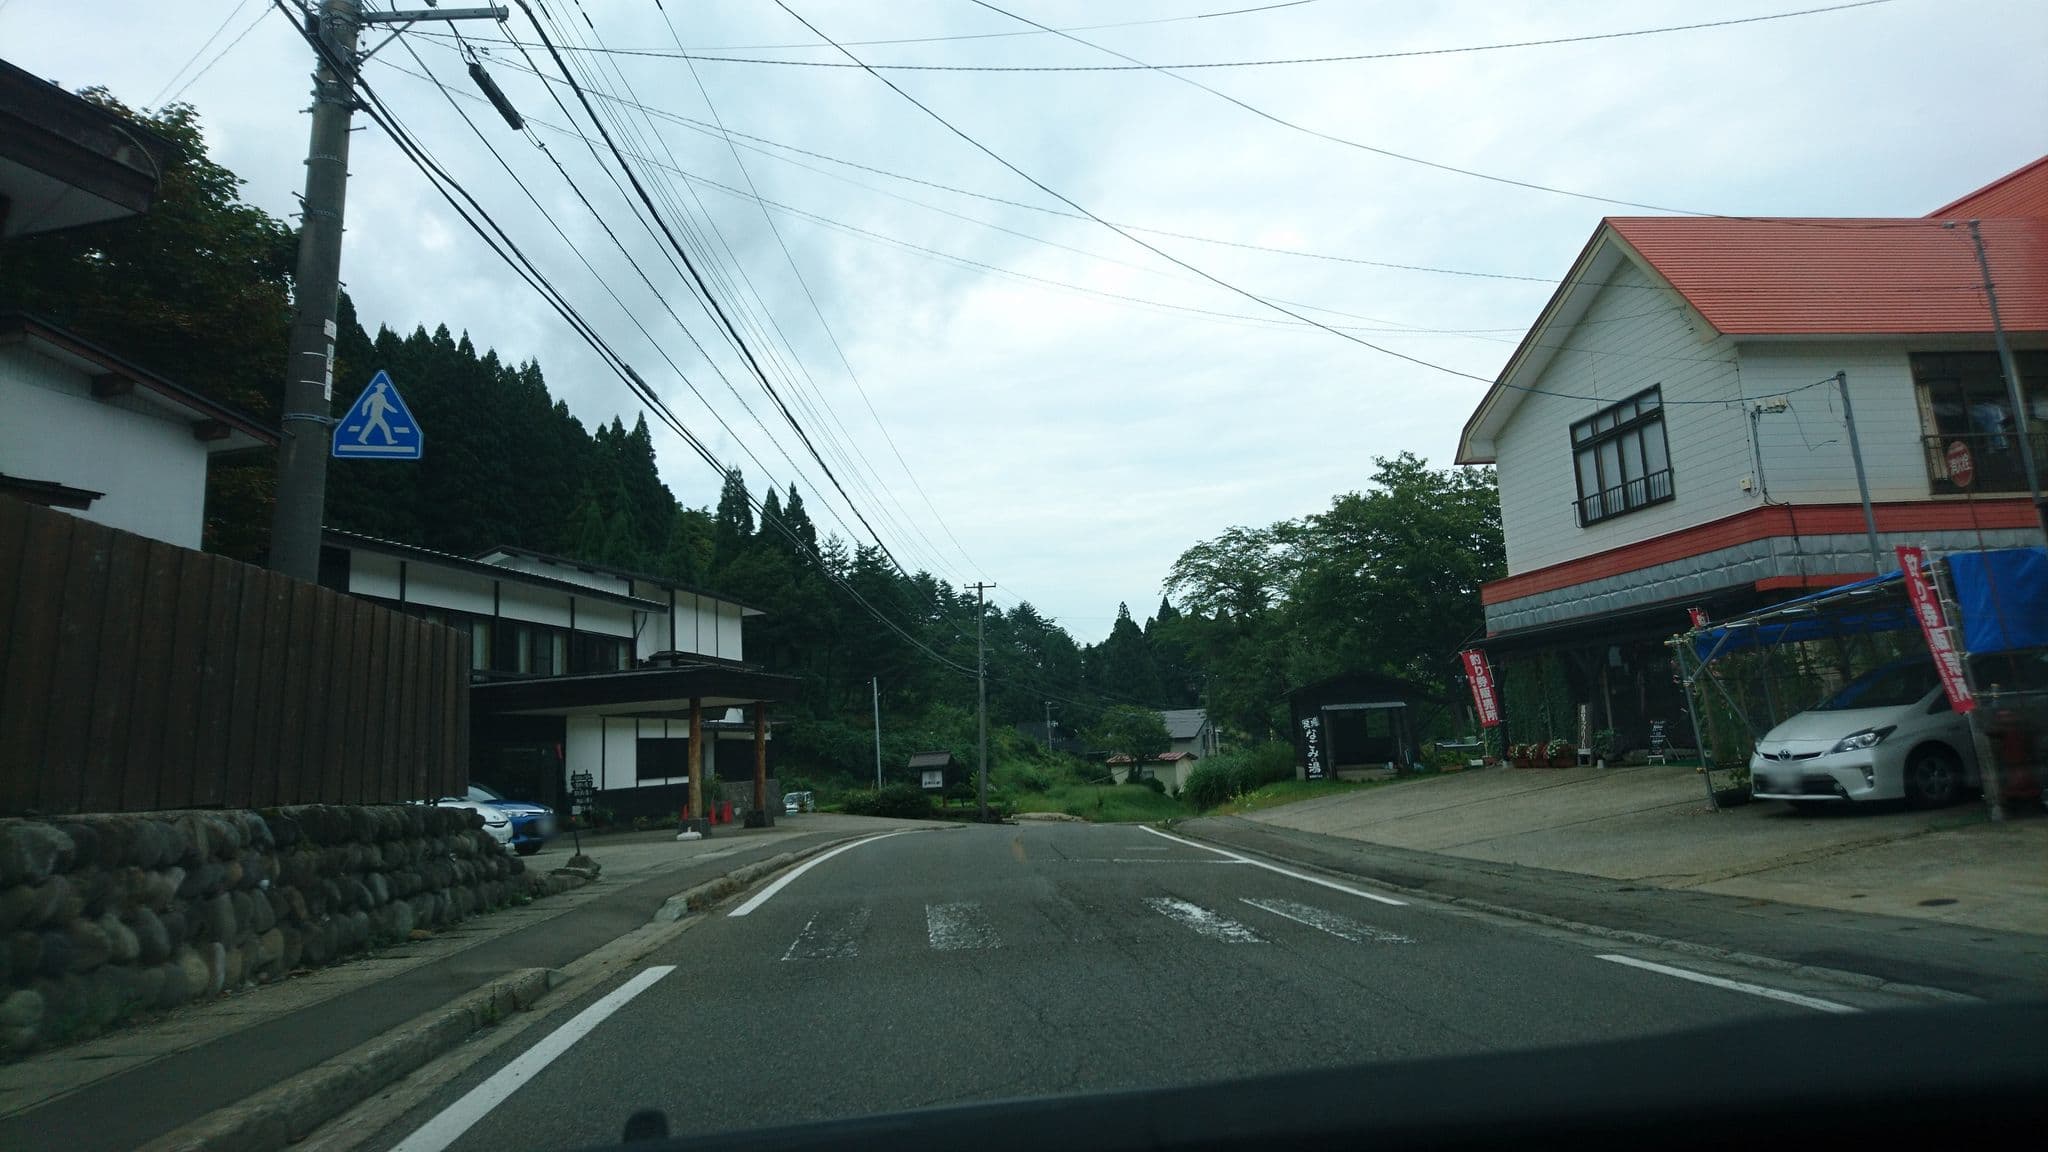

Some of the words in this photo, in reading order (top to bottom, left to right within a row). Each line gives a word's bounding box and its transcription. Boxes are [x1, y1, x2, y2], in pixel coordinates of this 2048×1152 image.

[1903, 553, 1971, 701] 釣り券販売所
[1469, 654, 1498, 722] 釣り券販売所
